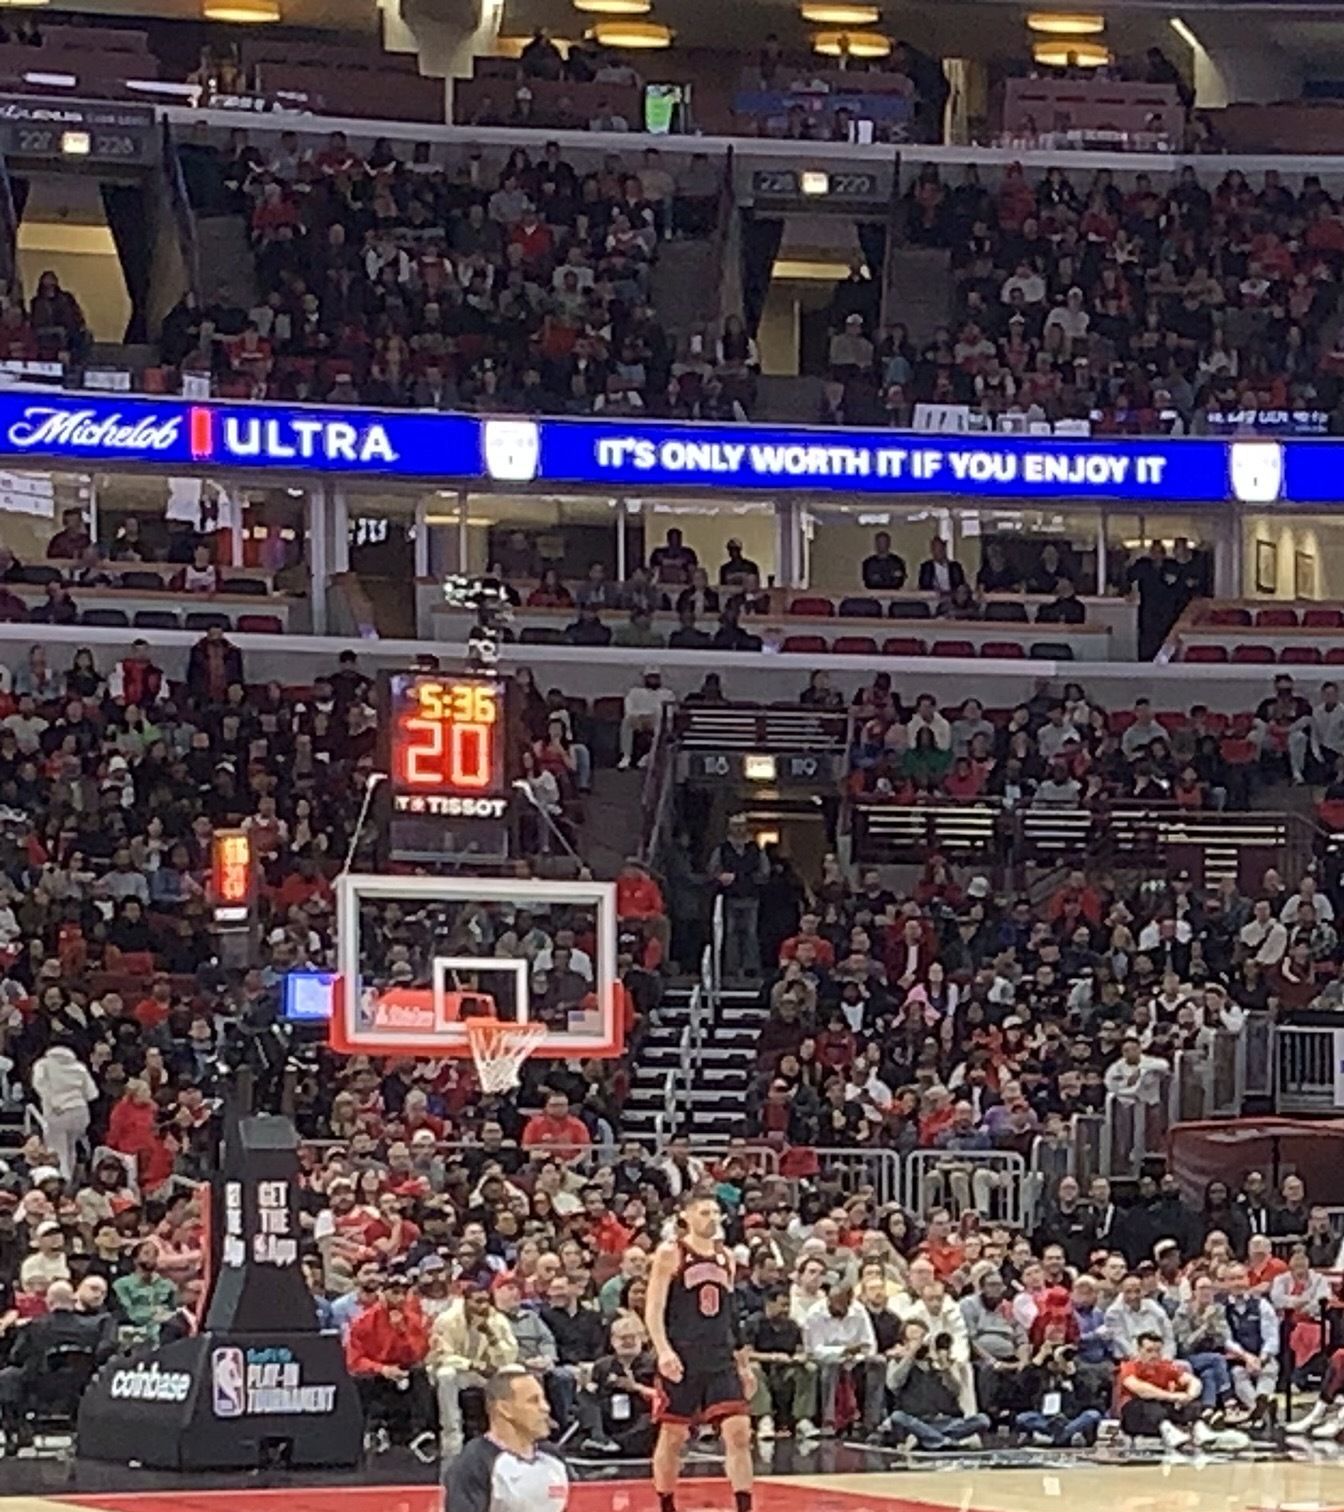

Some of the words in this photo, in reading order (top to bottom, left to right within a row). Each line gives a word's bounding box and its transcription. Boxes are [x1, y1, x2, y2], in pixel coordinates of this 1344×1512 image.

[8, 406, 184, 450] Michelob
[225, 417, 399, 462] ULTRA
[596, 436, 656, 469] IT'S
[660, 441, 746, 472] ONLY
[750, 445, 870, 477] WORTH
[876, 450, 907, 478] IT
[911, 451, 942, 479] IF
[948, 452, 1016, 482] YOU
[1023, 454, 1130, 484] ENJOY
[1136, 456, 1167, 484] IT
[420, 684, 497, 723] 5:36
[407, 720, 489, 786] 20
[427, 796, 506, 817] TISSOT
[111, 1361, 191, 1401] coinbase
